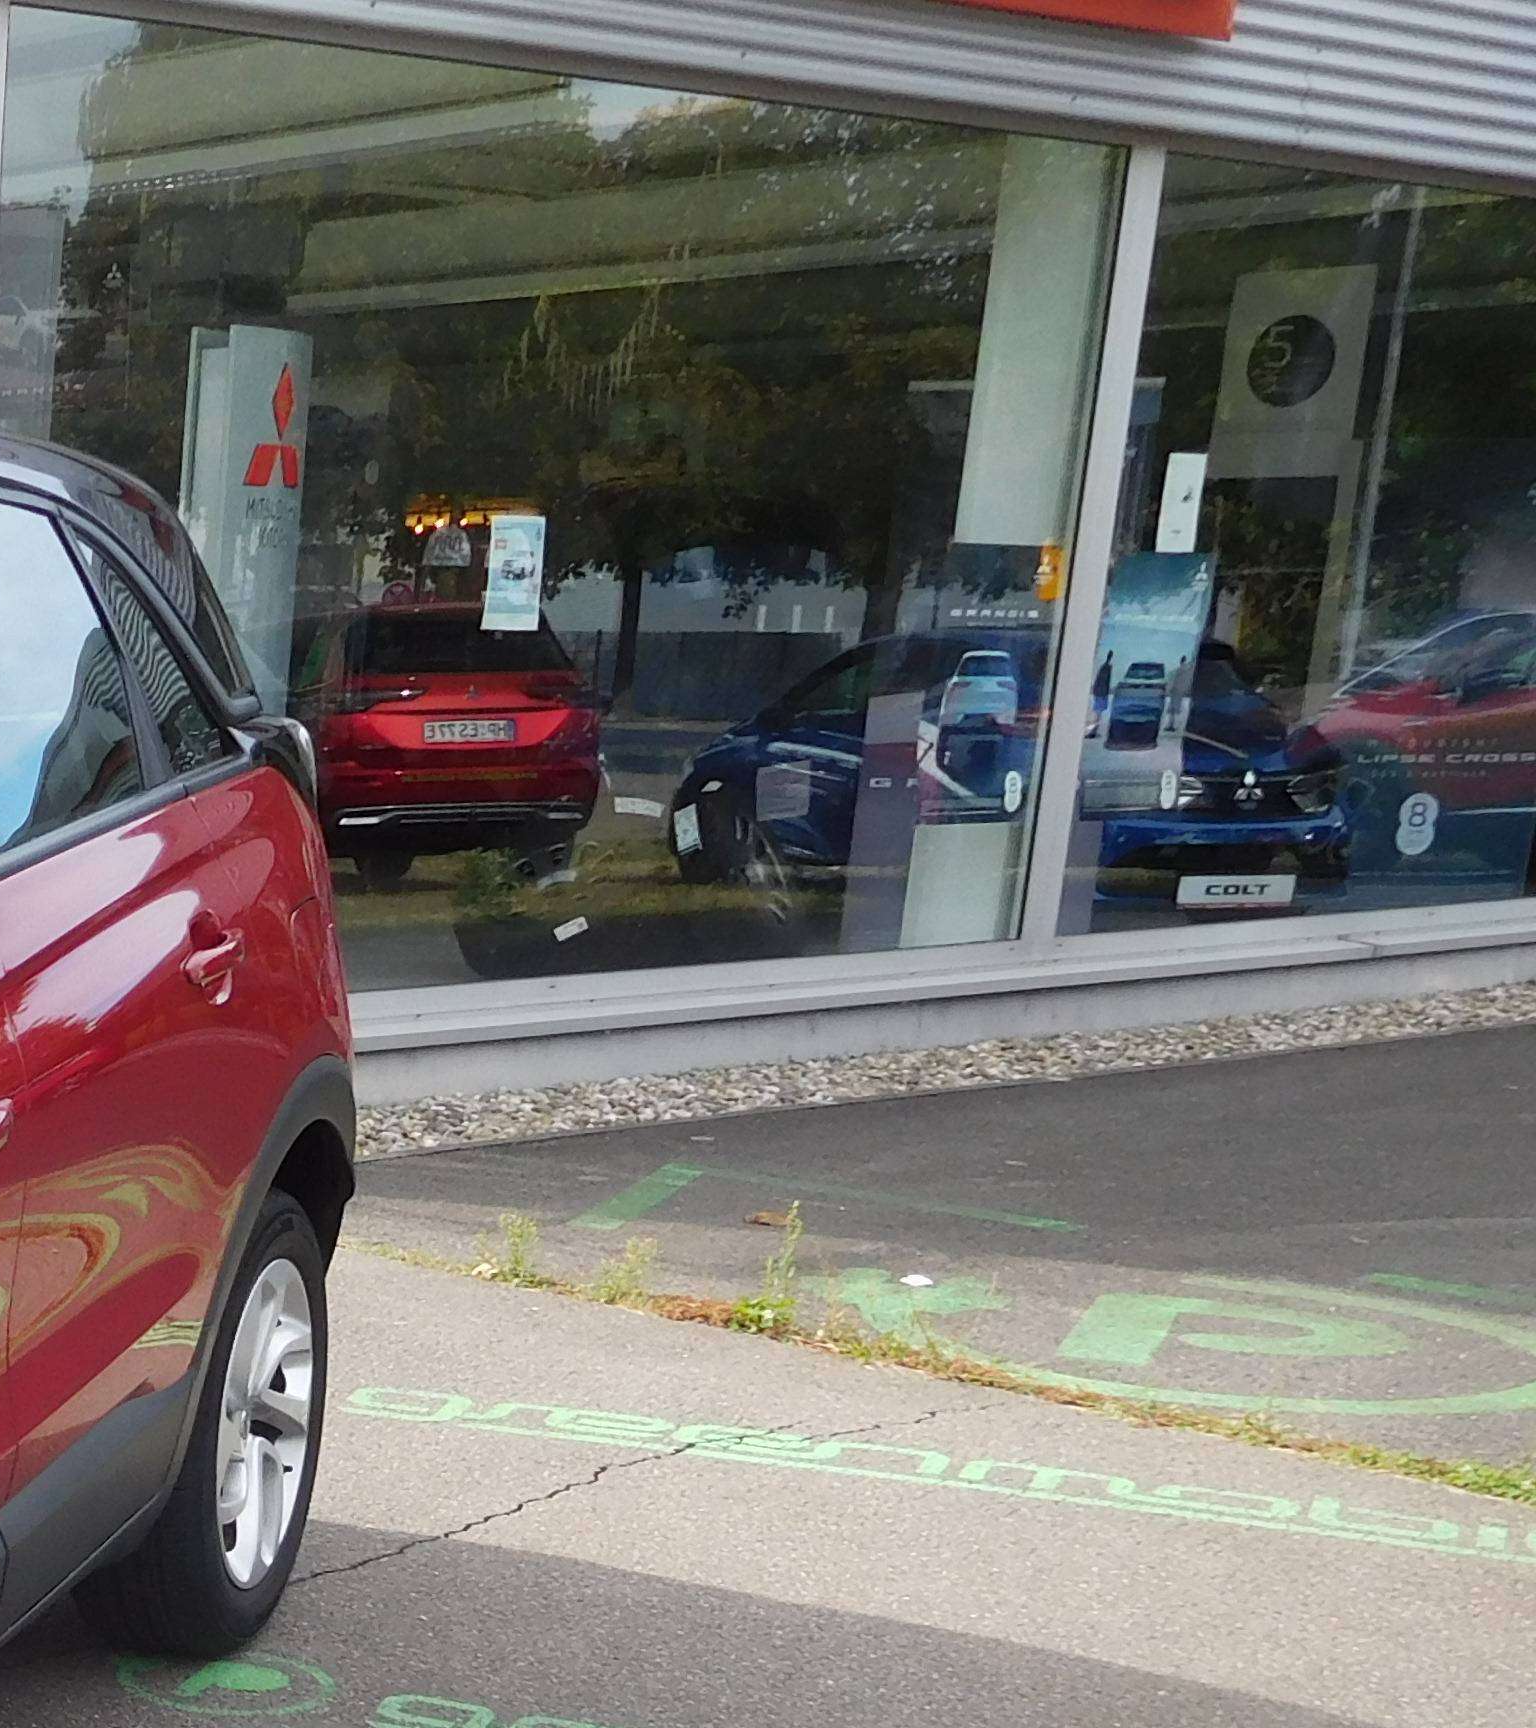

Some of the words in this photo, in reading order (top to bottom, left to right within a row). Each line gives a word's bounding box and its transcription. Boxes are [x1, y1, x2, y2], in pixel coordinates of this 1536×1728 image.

[1409, 802, 1427, 827] 8
[1204, 883, 1272, 897] COLT
[342, 1386, 1536, 1556] greenmobi
